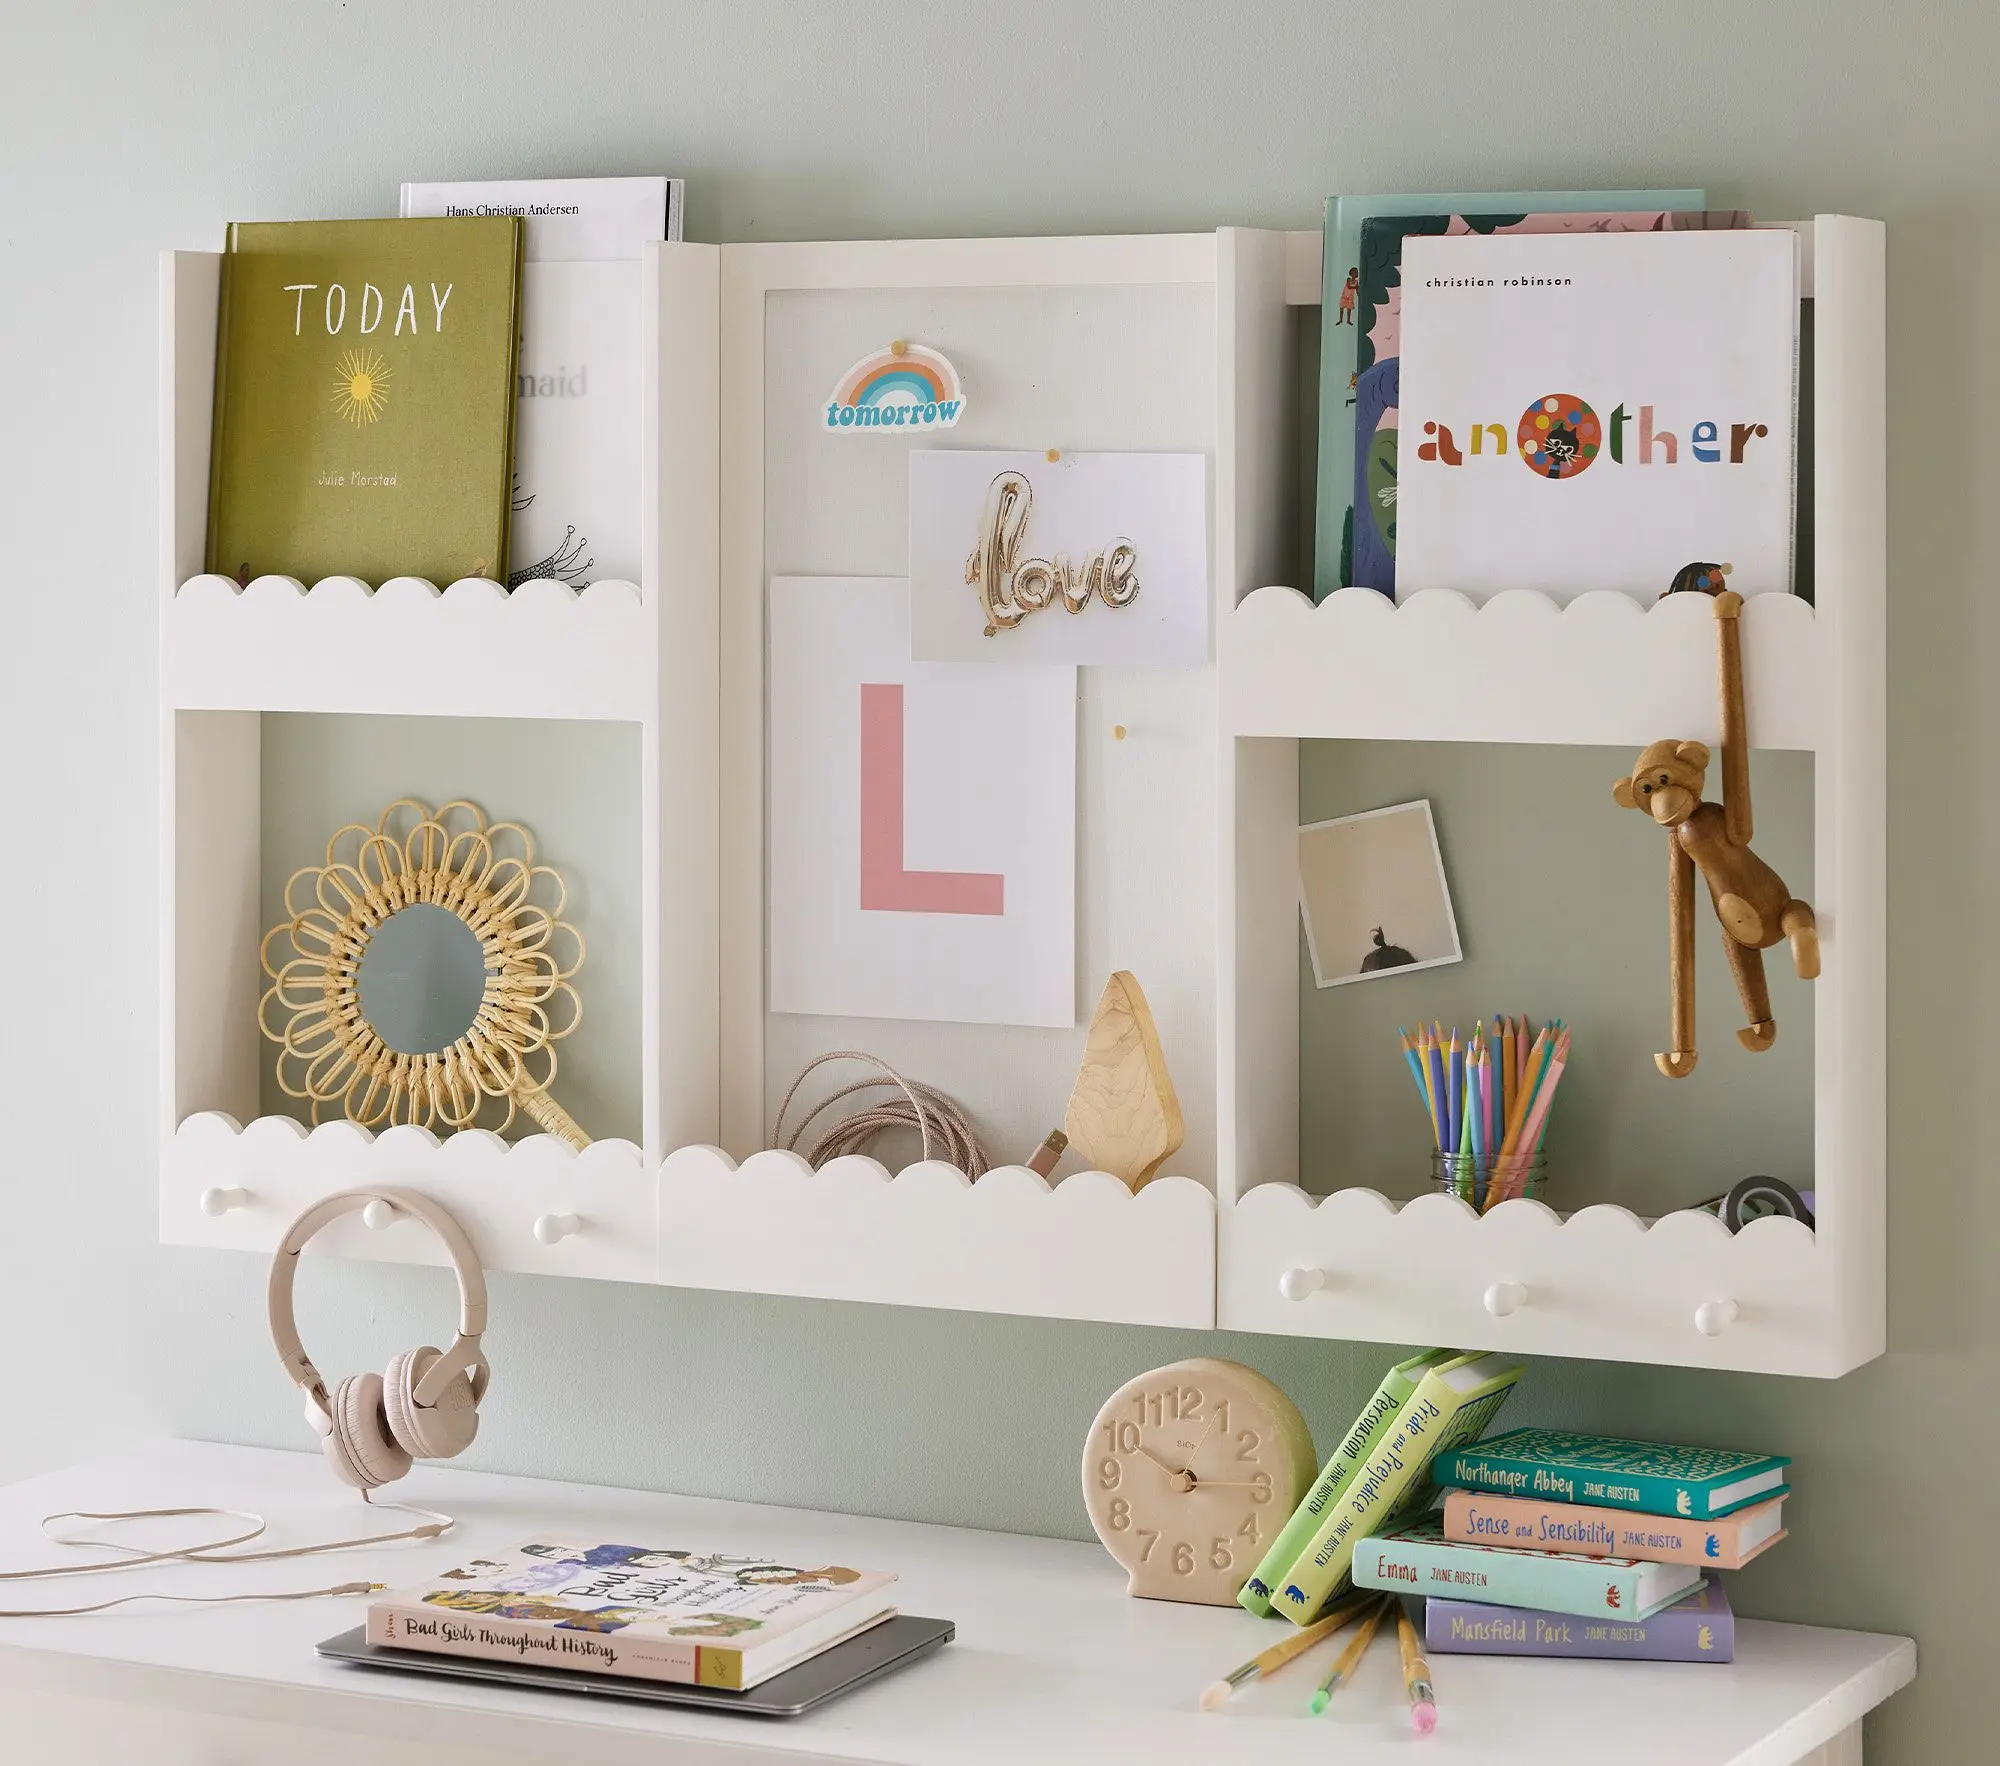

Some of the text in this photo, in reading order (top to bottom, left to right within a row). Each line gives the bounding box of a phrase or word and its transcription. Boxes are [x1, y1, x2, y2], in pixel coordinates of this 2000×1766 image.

[446, 203, 579, 217] Hans Christian Andersen
[1426, 276, 1572, 288] christian robinson
[283, 282, 453, 337] TODAY
[517, 363, 588, 398] maid
[827, 397, 961, 427] tomorrow
[318, 470, 398, 486] Julie Morstad
[964, 470, 1140, 638] love
[860, 683, 1004, 916] L
[1132, 1391, 1164, 1428] 11
[1165, 1386, 1204, 1423] 12
[1213, 1398, 1231, 1434] 1
[1102, 1419, 1142, 1456] 10
[1236, 1429, 1261, 1464] 2
[1308, 1390, 1400, 1516] Persuasion JANE AUSTEN
[1098, 1456, 1122, 1490] 9
[1250, 1471, 1274, 1504] 3
[1314, 1398, 1441, 1568] Pride and Prejudice JANE AUSTEN
[1455, 1459, 1640, 1502] Northanger Abbey JANE AUSTEN
[1107, 1496, 1132, 1533] 8
[1237, 1511, 1263, 1546] 4
[1466, 1508, 1682, 1553] Sense and Sensibility JANE AUSTEN
[1136, 1528, 1162, 1563] 7
[1170, 1541, 1196, 1577] 6
[1208, 1535, 1235, 1571] 5
[557, 1571, 640, 1597] Bad
[1378, 1555, 1488, 1587] Emma JANE AUSTEN
[607, 1576, 688, 1604] Girls
[404, 1617, 438, 1636] Bad
[440, 1622, 475, 1642] Girls
[479, 1628, 558, 1655] Throughout
[561, 1637, 618, 1667] History
[1451, 1617, 1646, 1643] Mansfield Park JANE AUSTEN
